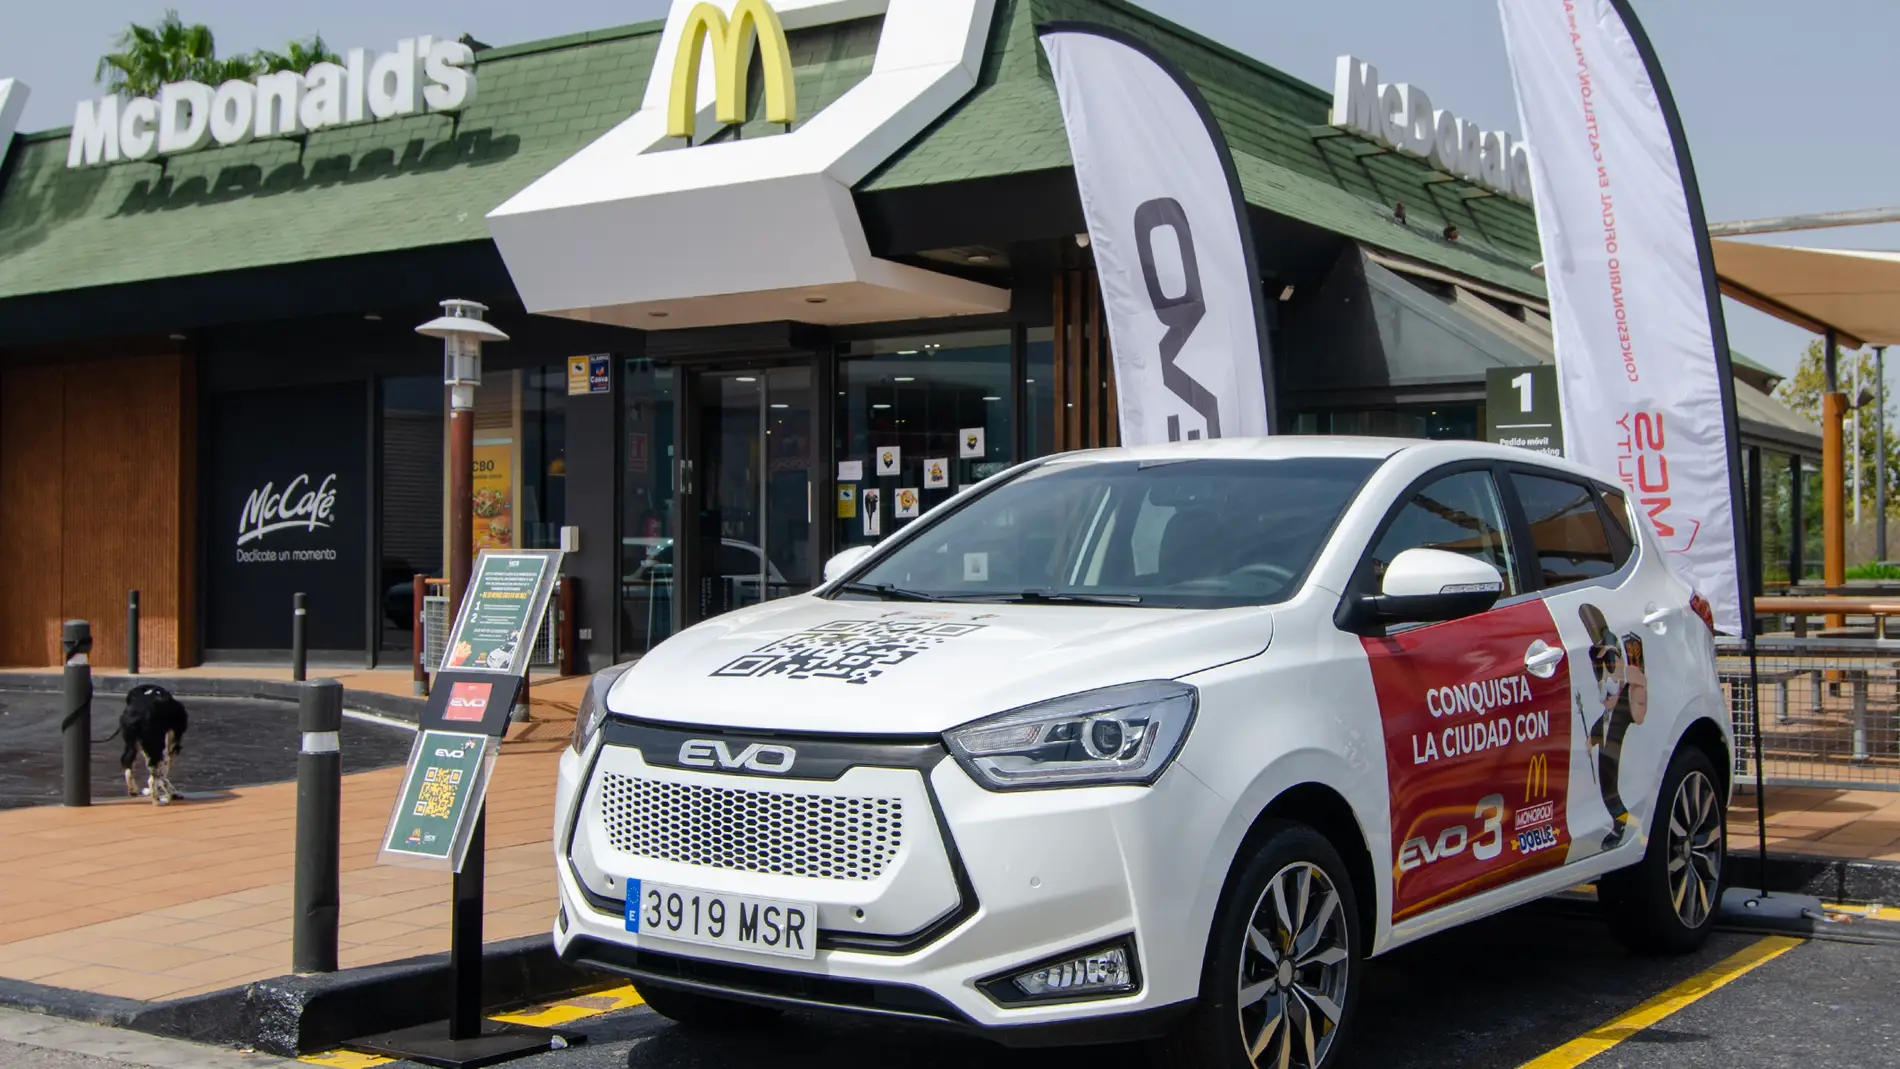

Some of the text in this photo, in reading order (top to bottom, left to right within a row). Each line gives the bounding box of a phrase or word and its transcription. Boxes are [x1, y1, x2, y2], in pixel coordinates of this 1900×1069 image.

[67, 35, 476, 168] McDonald's
[1512, 372, 1532, 412] 1
[1500, 436, 1549, 446] Pedido móvil
[238, 473, 337, 542] McCafé
[279, 550, 290, 561] un
[292, 549, 337, 561] momento
[450, 697, 485, 708] EVO
[1426, 675, 1532, 718] CONQUISTA
[435, 748, 464, 758] EVO
[1412, 710, 1549, 765] LA CIUDAD CON
[679, 739, 796, 773] EVO
[1516, 804, 1552, 826] MONOPOLY
[1518, 825, 1556, 853] DOBLE
[629, 910, 636, 921] E
[646, 889, 807, 950] 3919 MSR
